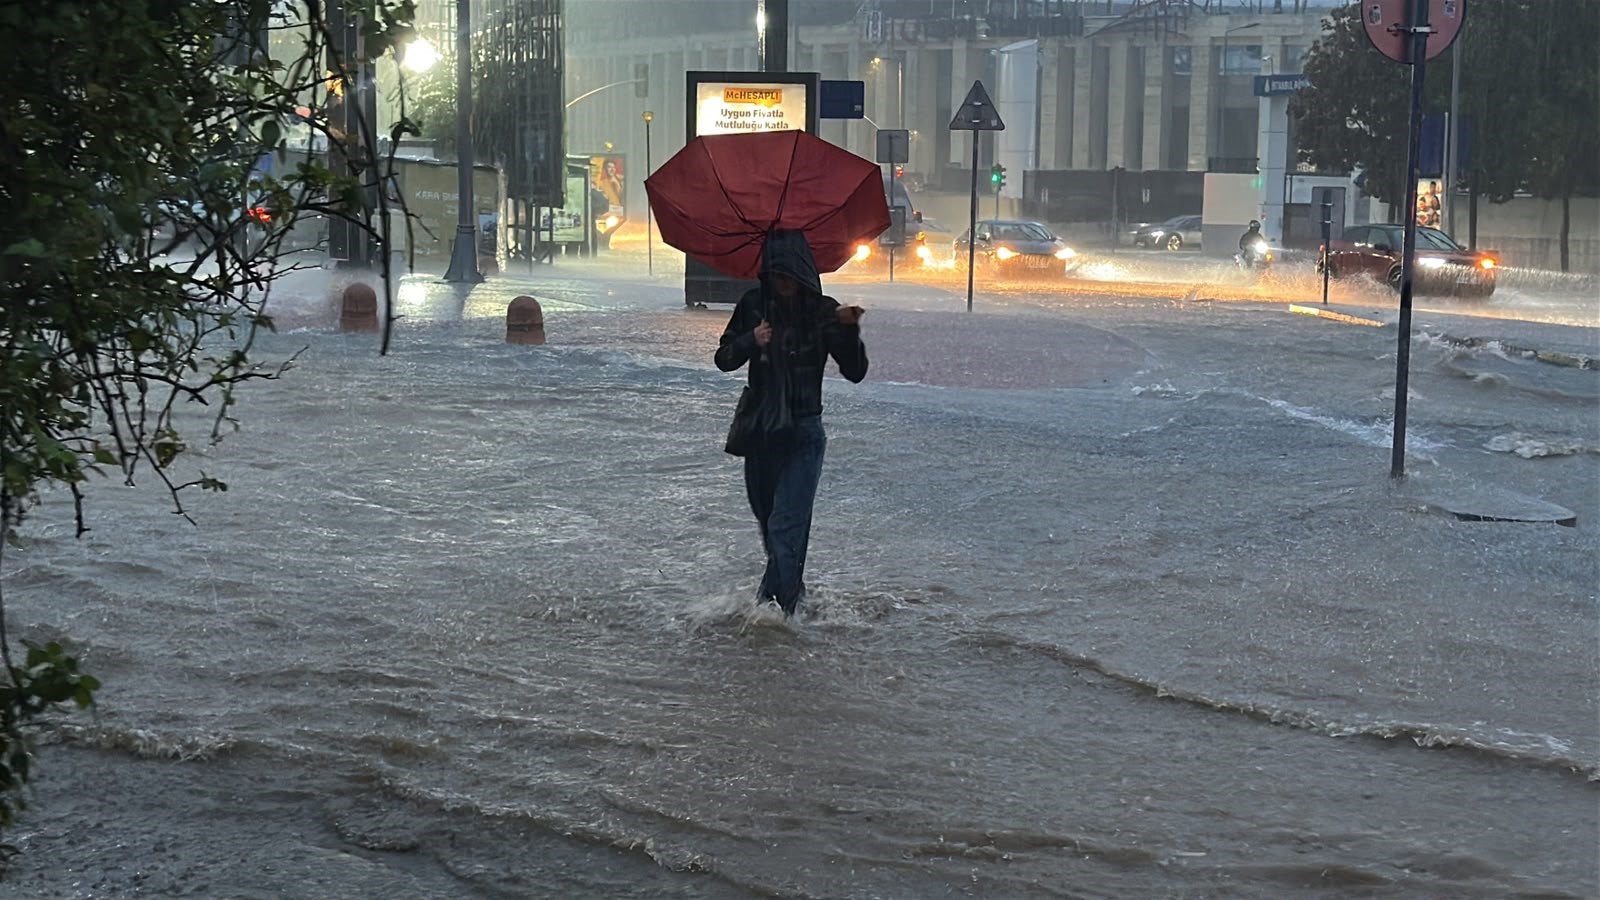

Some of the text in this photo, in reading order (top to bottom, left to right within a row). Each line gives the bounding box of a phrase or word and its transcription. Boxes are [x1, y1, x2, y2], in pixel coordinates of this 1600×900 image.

[726, 91, 779, 100] McHESAPLI
[721, 108, 751, 119] Uygun
[715, 121, 789, 131] Mutluluğu Katla
